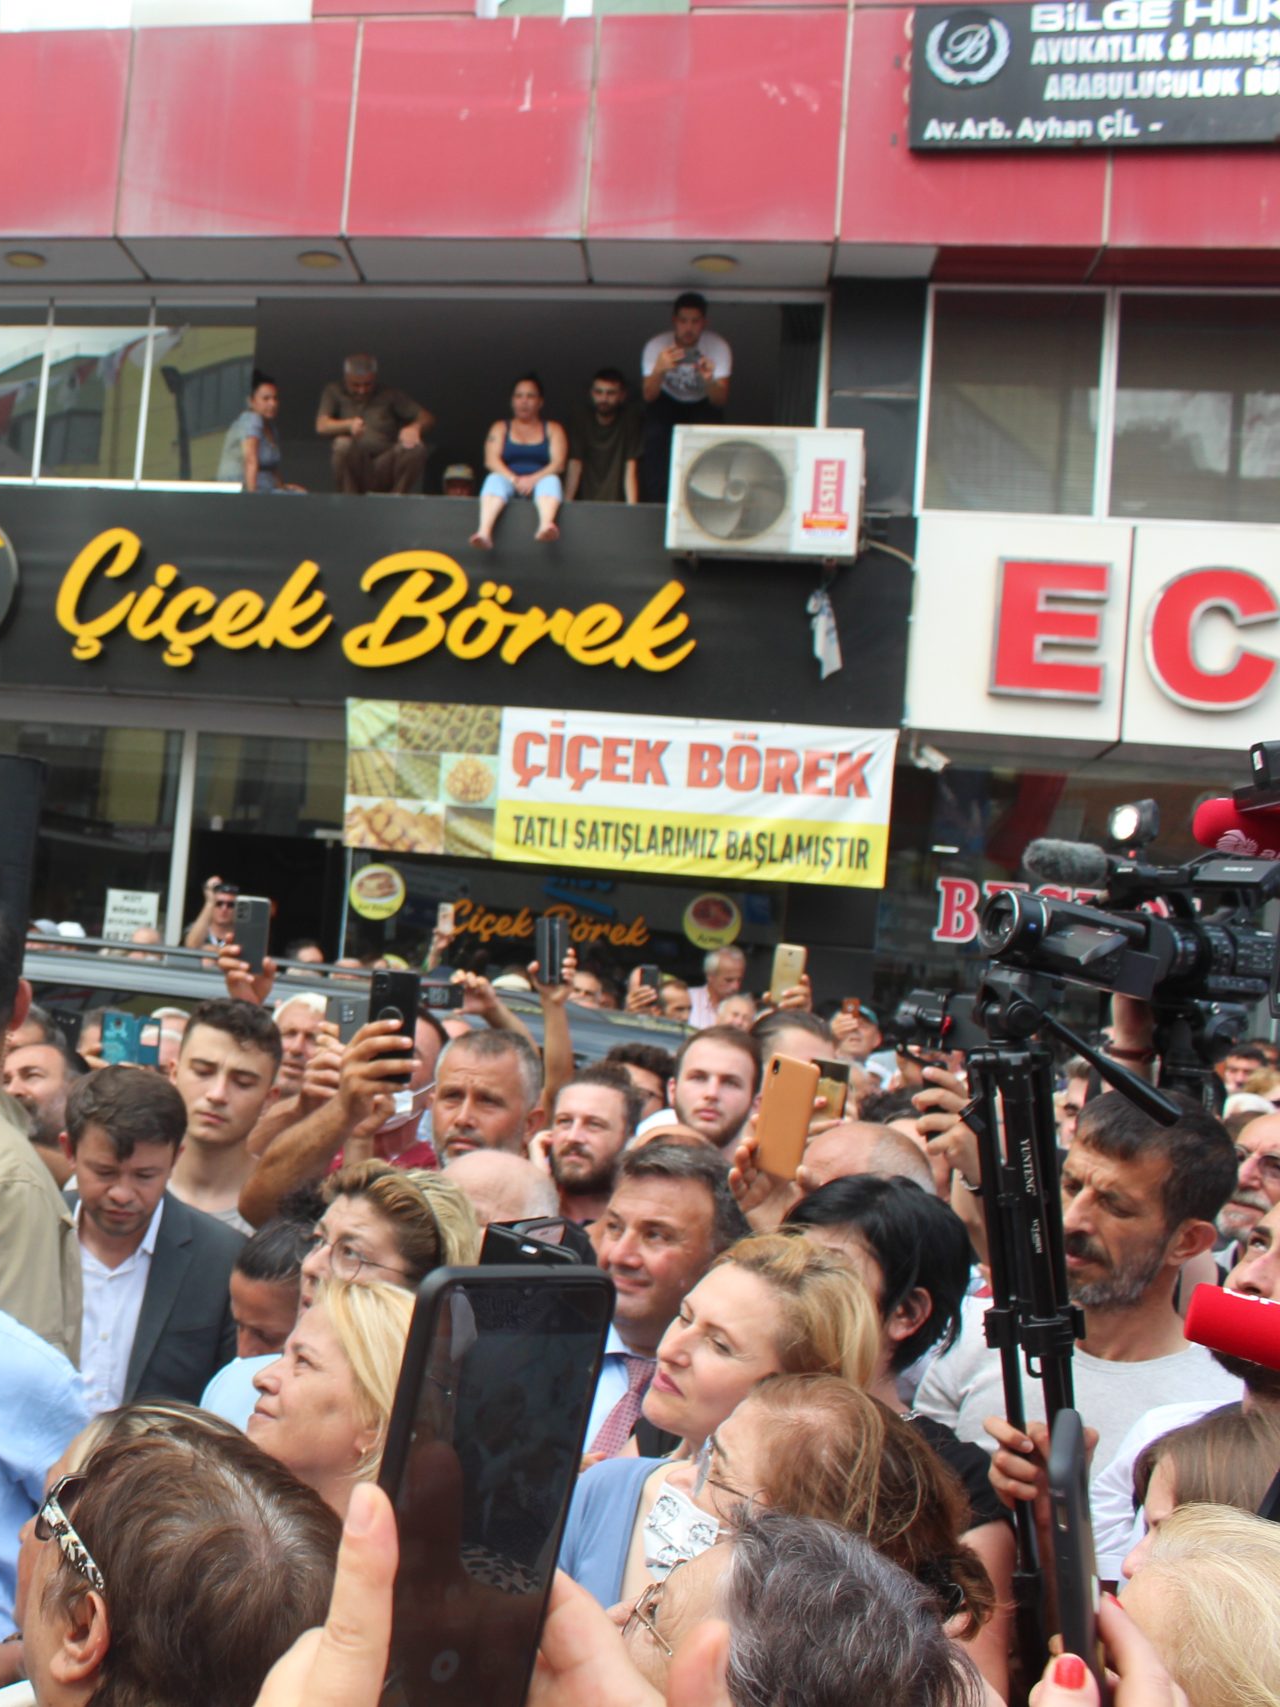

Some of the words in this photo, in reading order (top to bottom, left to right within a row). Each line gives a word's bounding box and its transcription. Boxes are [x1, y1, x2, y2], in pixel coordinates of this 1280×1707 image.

[1030, 32, 1166, 66] AVUKATLIK
[1168, 31, 1190, 62] &
[1043, 66, 1242, 101] ARABULUCULUK
[1018, 117, 1093, 143] Ayhan
[55, 527, 333, 668] Çiçek
[341, 549, 697, 673] Börek
[512, 721, 671, 792] ÇİÇEK
[686, 732, 874, 799] BÖREK
[513, 814, 568, 849] TATLI
[574, 819, 717, 862] SATIŞLARIMIZ
[725, 829, 871, 875] BAŞLAMIŞTIR
[1020, 1138, 1035, 1193] YUNTENG
